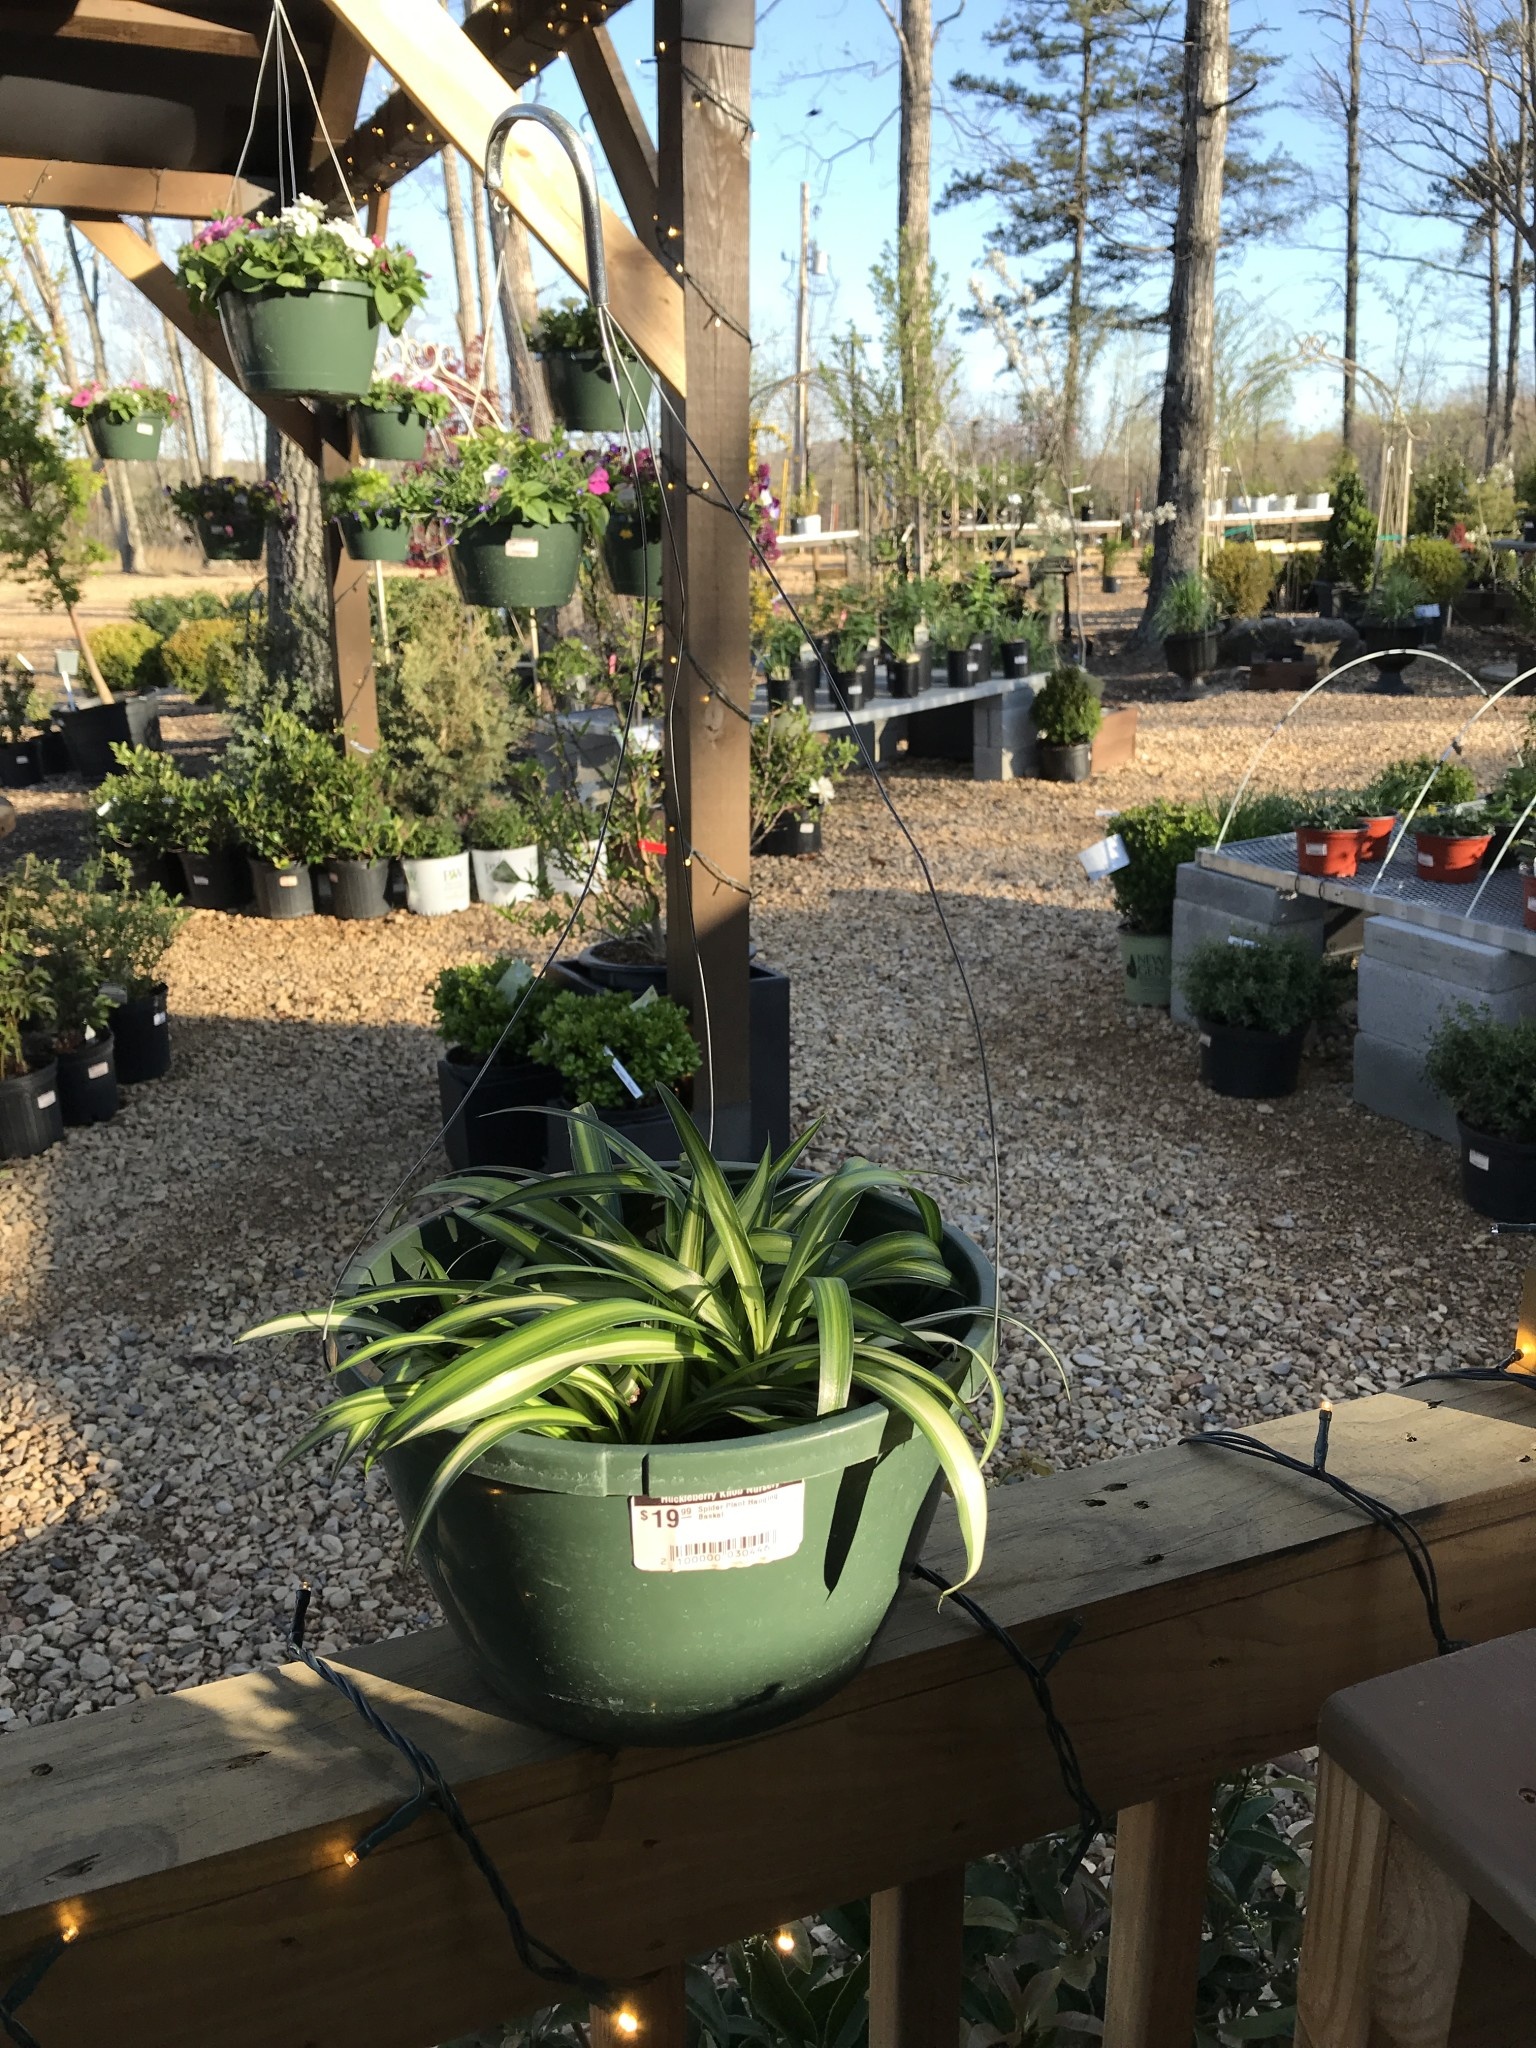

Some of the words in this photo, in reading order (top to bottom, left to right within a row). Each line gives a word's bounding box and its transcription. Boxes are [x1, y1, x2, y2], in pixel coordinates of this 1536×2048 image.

[698, 1505, 723, 1514] Spider
[726, 1500, 745, 1508] Plant
[698, 1511, 723, 1520] Basket
